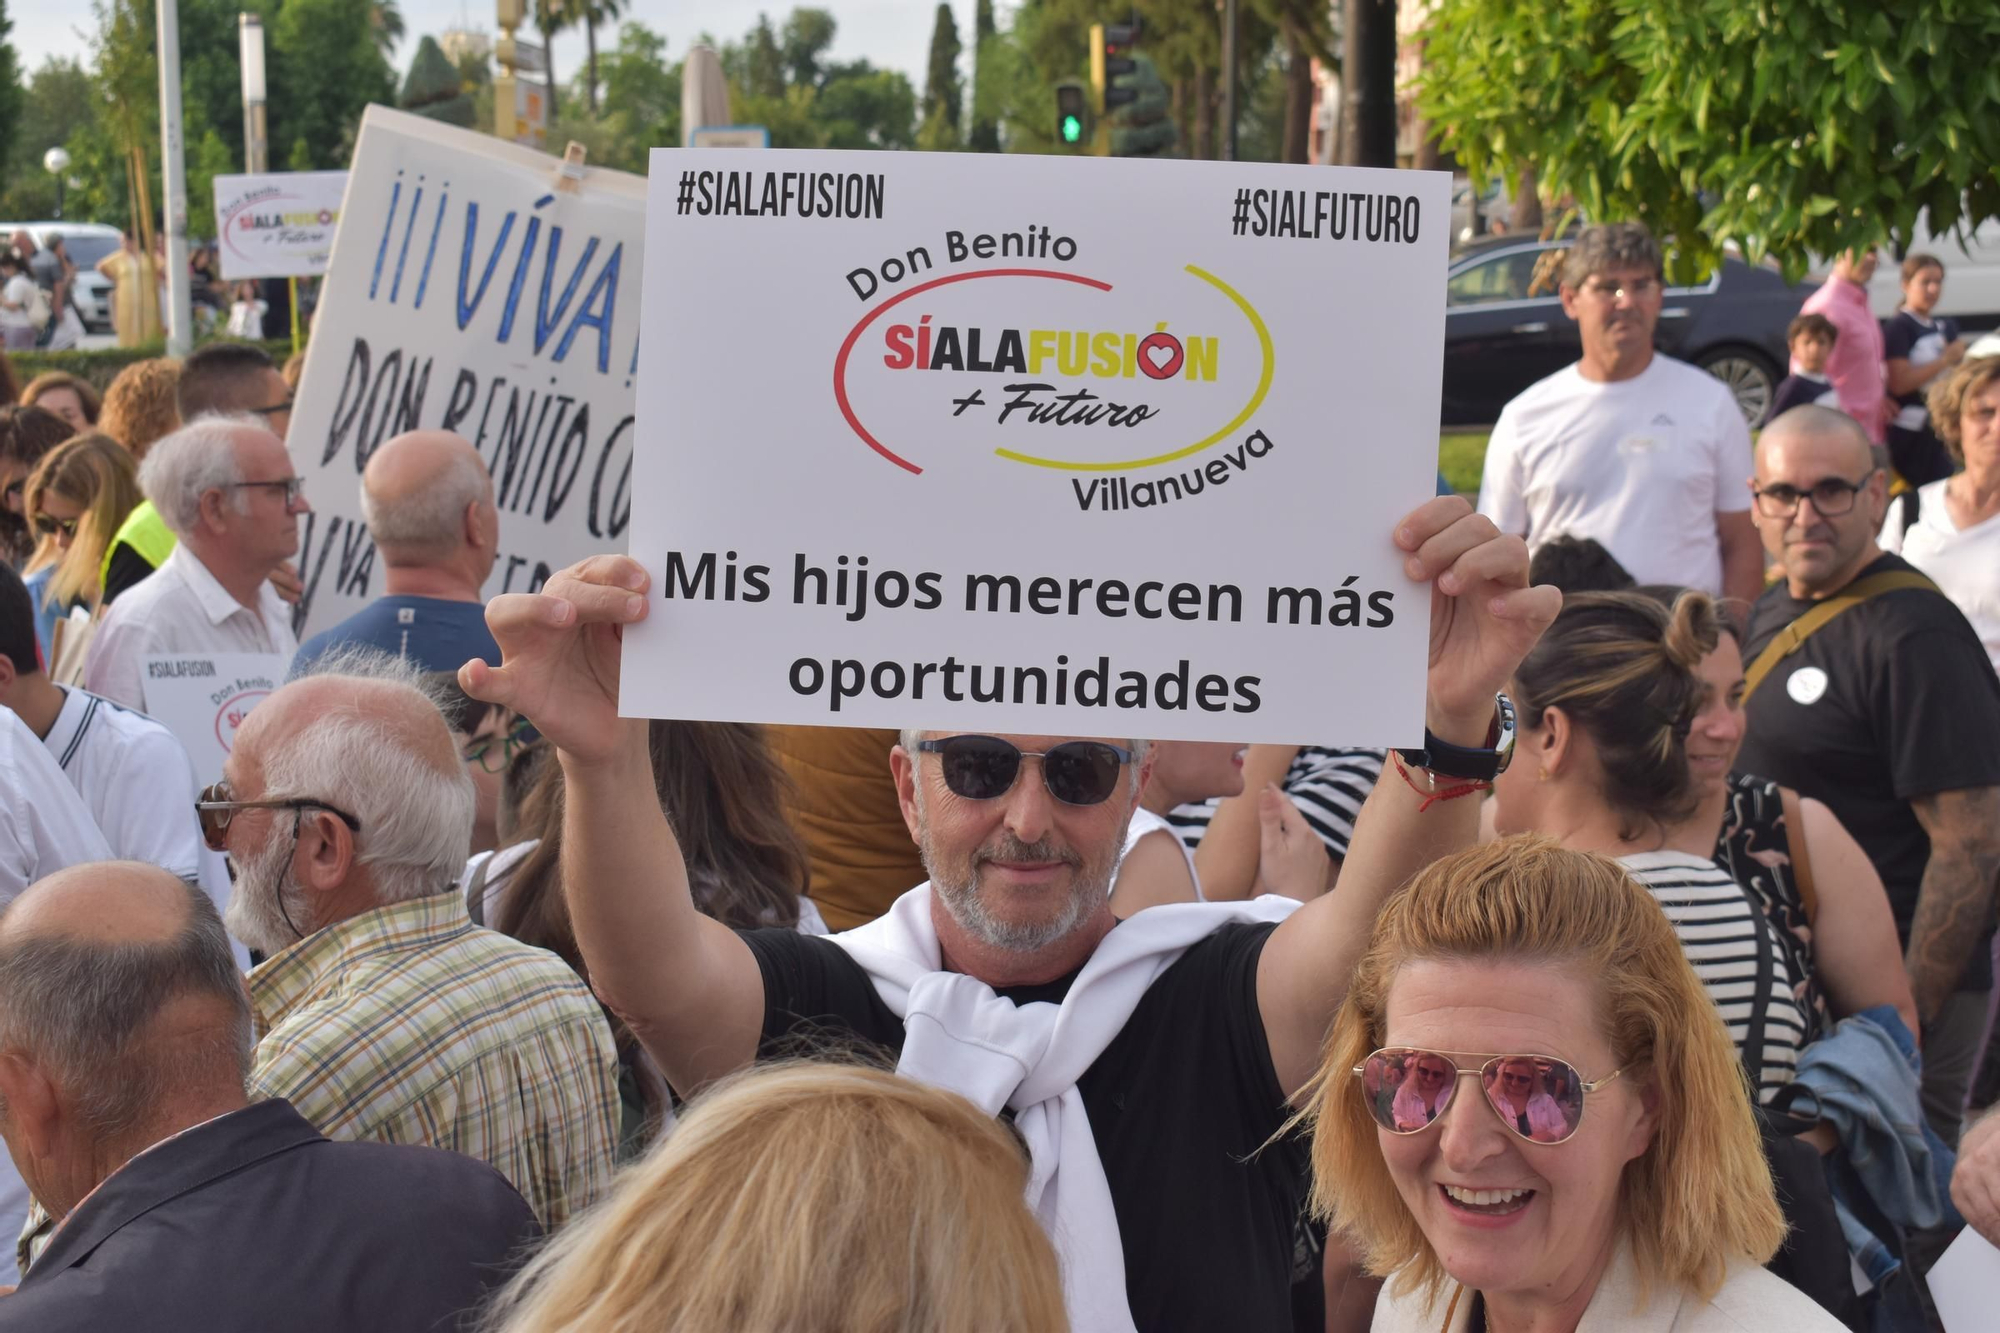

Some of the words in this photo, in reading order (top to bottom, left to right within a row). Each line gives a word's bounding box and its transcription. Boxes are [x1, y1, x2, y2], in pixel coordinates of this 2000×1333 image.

[676, 170, 885, 220] #SIALAFUSION
[1231, 188, 1421, 244] #SIALFUTURO
[846, 247, 933, 302] Don
[946, 225, 1078, 269] Benito
[319, 336, 434, 476] DON
[997, 382, 1161, 428] Futuro
[1071, 428, 1275, 512] Villanueva
[664, 550, 771, 603] Mis
[793, 552, 943, 622] hijos
[965, 574, 1243, 623] merecen
[1266, 575, 1395, 630] más
[148, 660, 217, 679] #SIALAFUSION
[210, 683, 236, 706] Don
[236, 675, 275, 691] Benito
[788, 654, 1262, 714] oportunidades
